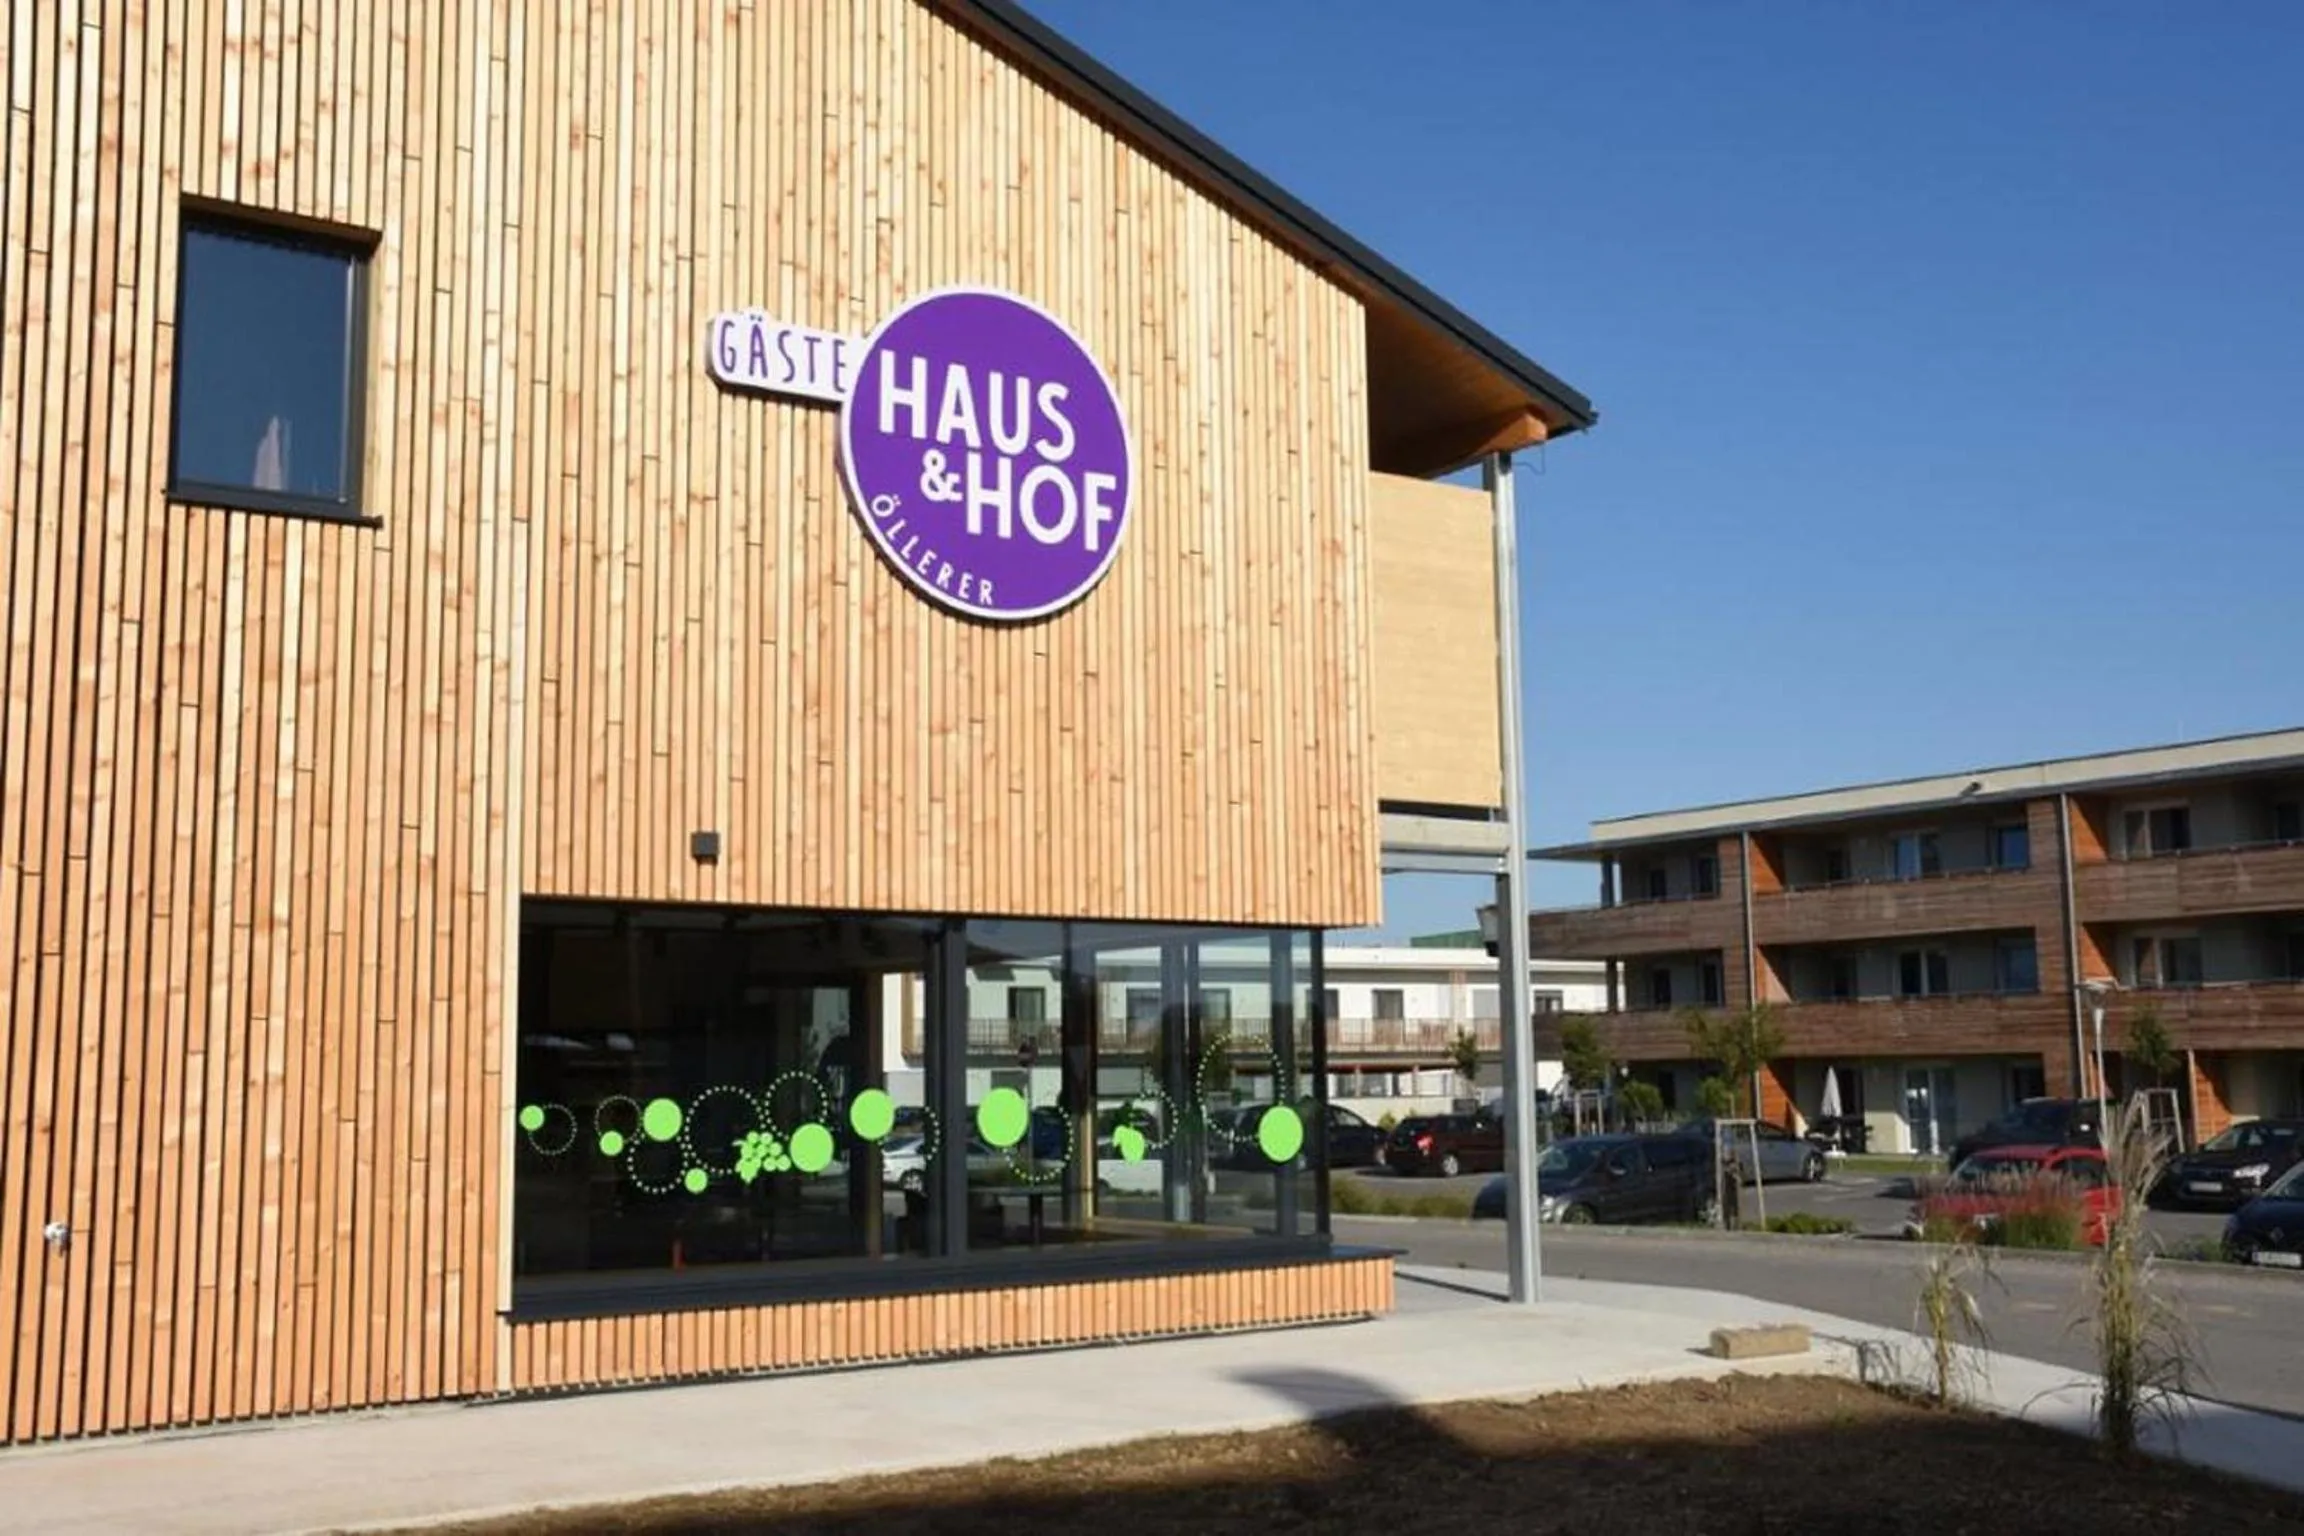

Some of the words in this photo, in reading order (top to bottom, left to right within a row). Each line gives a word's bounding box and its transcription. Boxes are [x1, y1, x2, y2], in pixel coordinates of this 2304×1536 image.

[719, 314, 848, 393] GÄSTE
[879, 349, 1076, 463] HAUS
[872, 493, 996, 607] ÖLLERER
